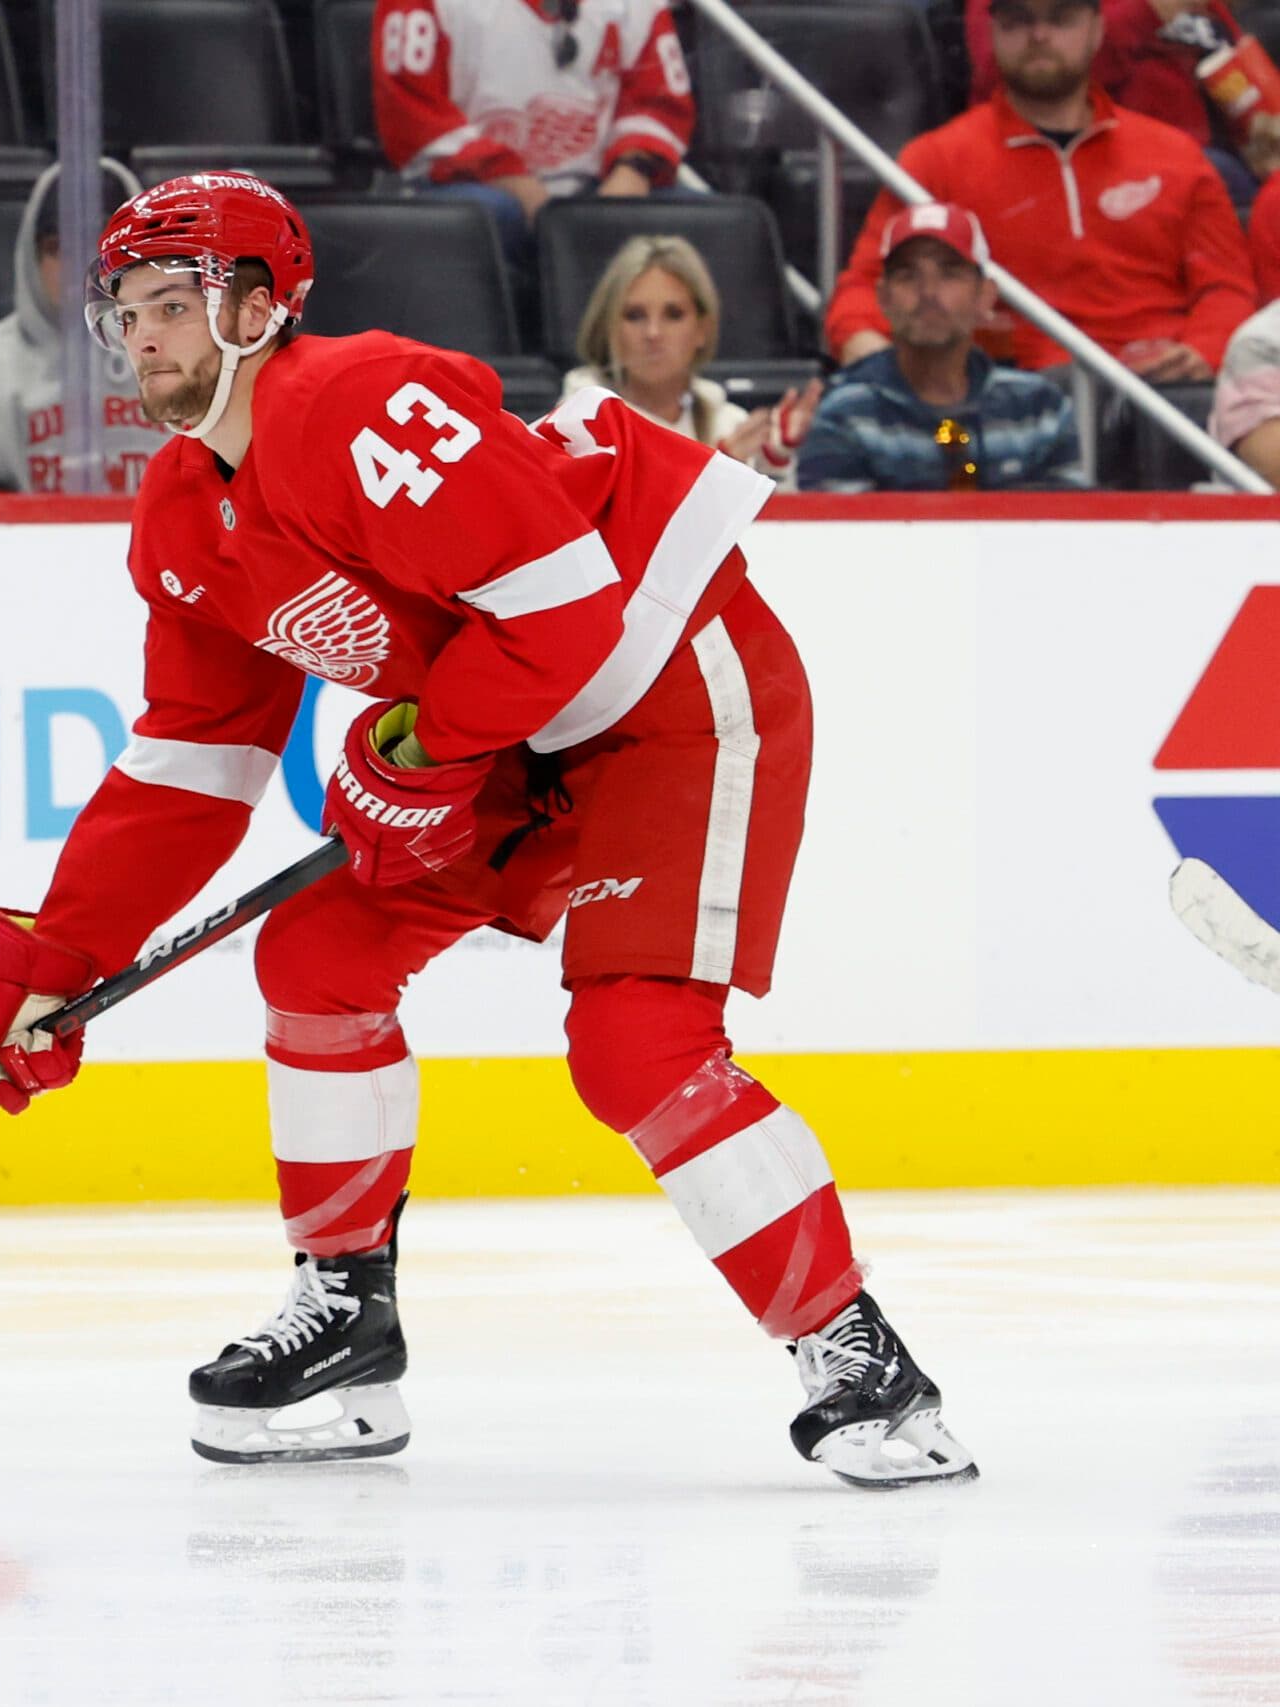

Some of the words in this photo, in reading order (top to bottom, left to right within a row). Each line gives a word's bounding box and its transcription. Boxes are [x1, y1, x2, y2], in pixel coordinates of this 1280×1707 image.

[383, 10, 436, 74] 88
[592, 21, 622, 77] A
[101, 224, 132, 251] CCM
[349, 381, 482, 509] 43
[568, 877, 644, 908] CM
[303, 1346, 351, 1379] BAUER
